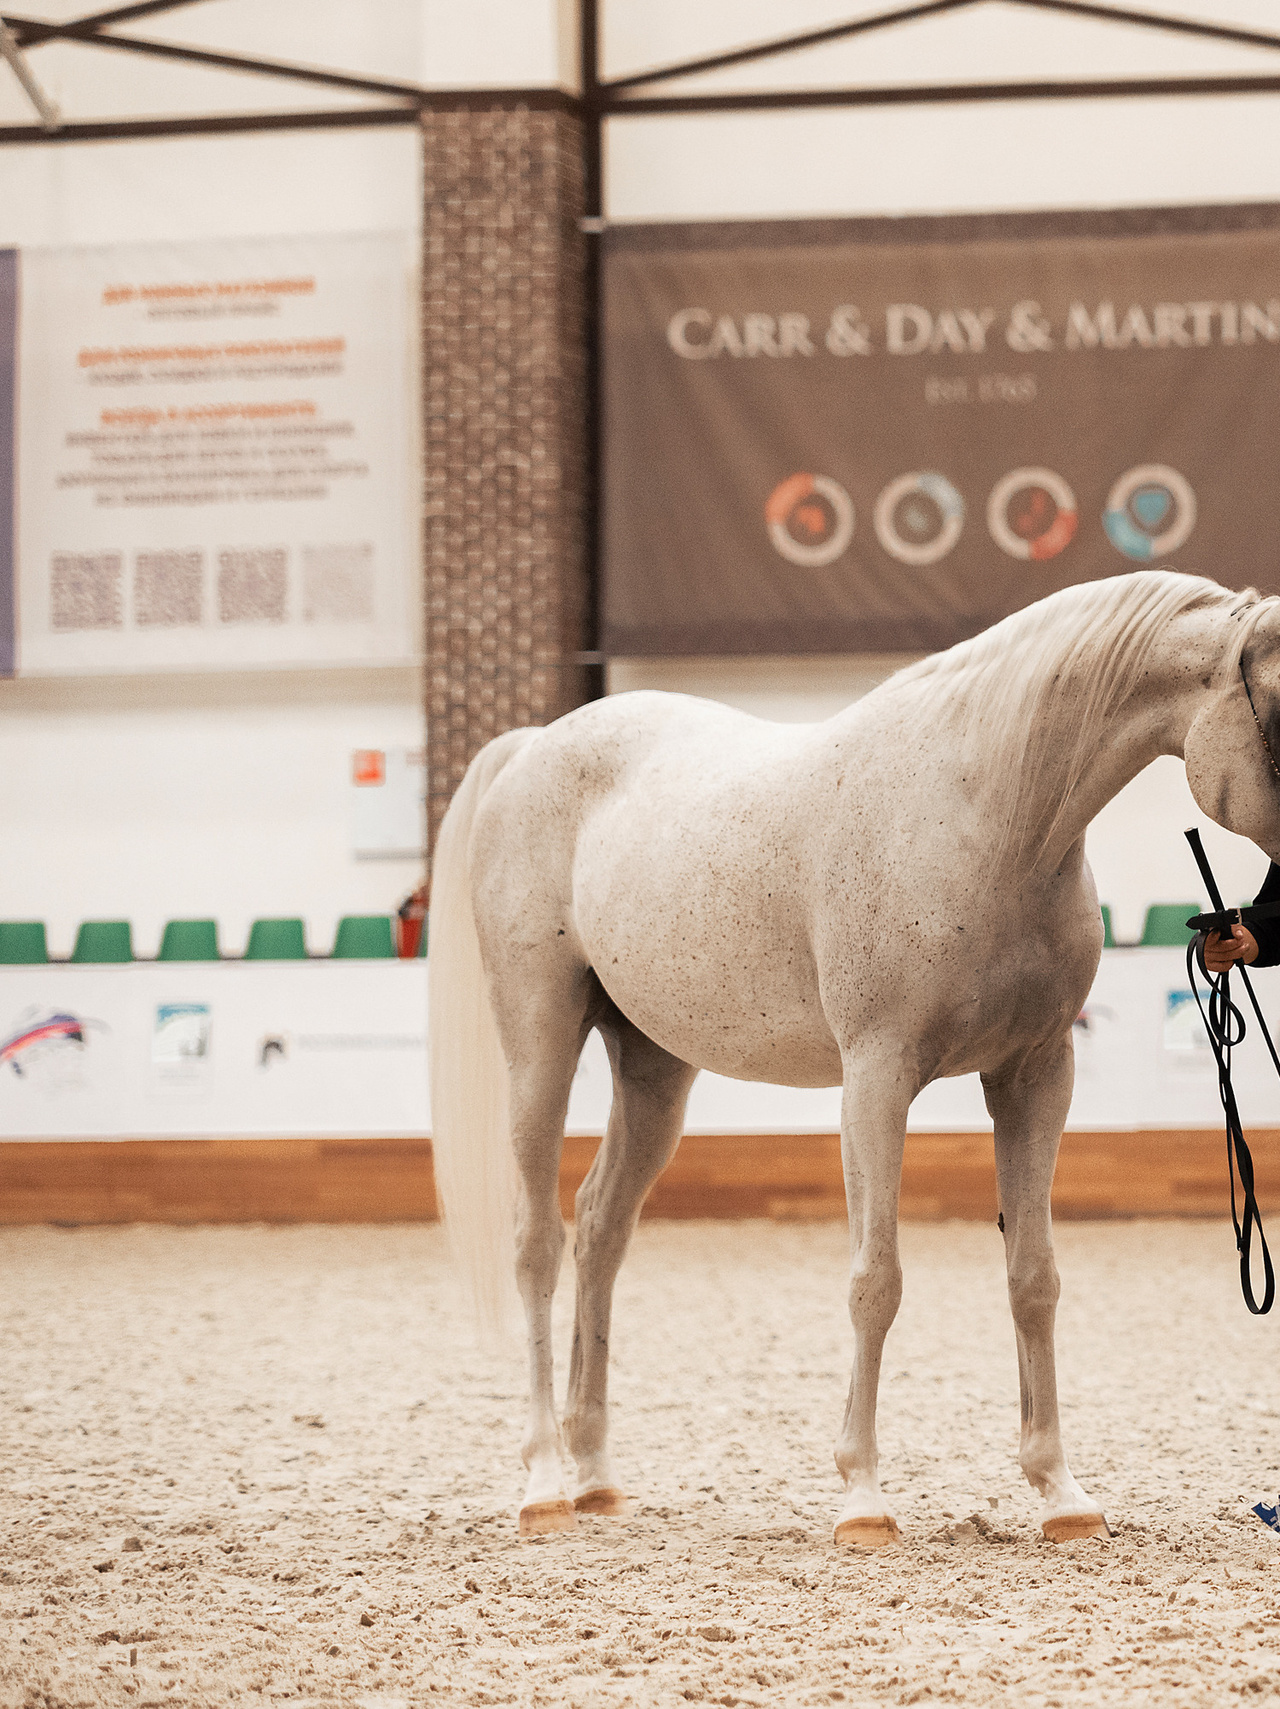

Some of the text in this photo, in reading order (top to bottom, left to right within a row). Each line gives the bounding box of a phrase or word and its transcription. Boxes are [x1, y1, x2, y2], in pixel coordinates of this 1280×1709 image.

[667, 305, 814, 360] CARR
[826, 304, 871, 357] &
[886, 303, 995, 356] DAY
[1006, 301, 1053, 354] &
